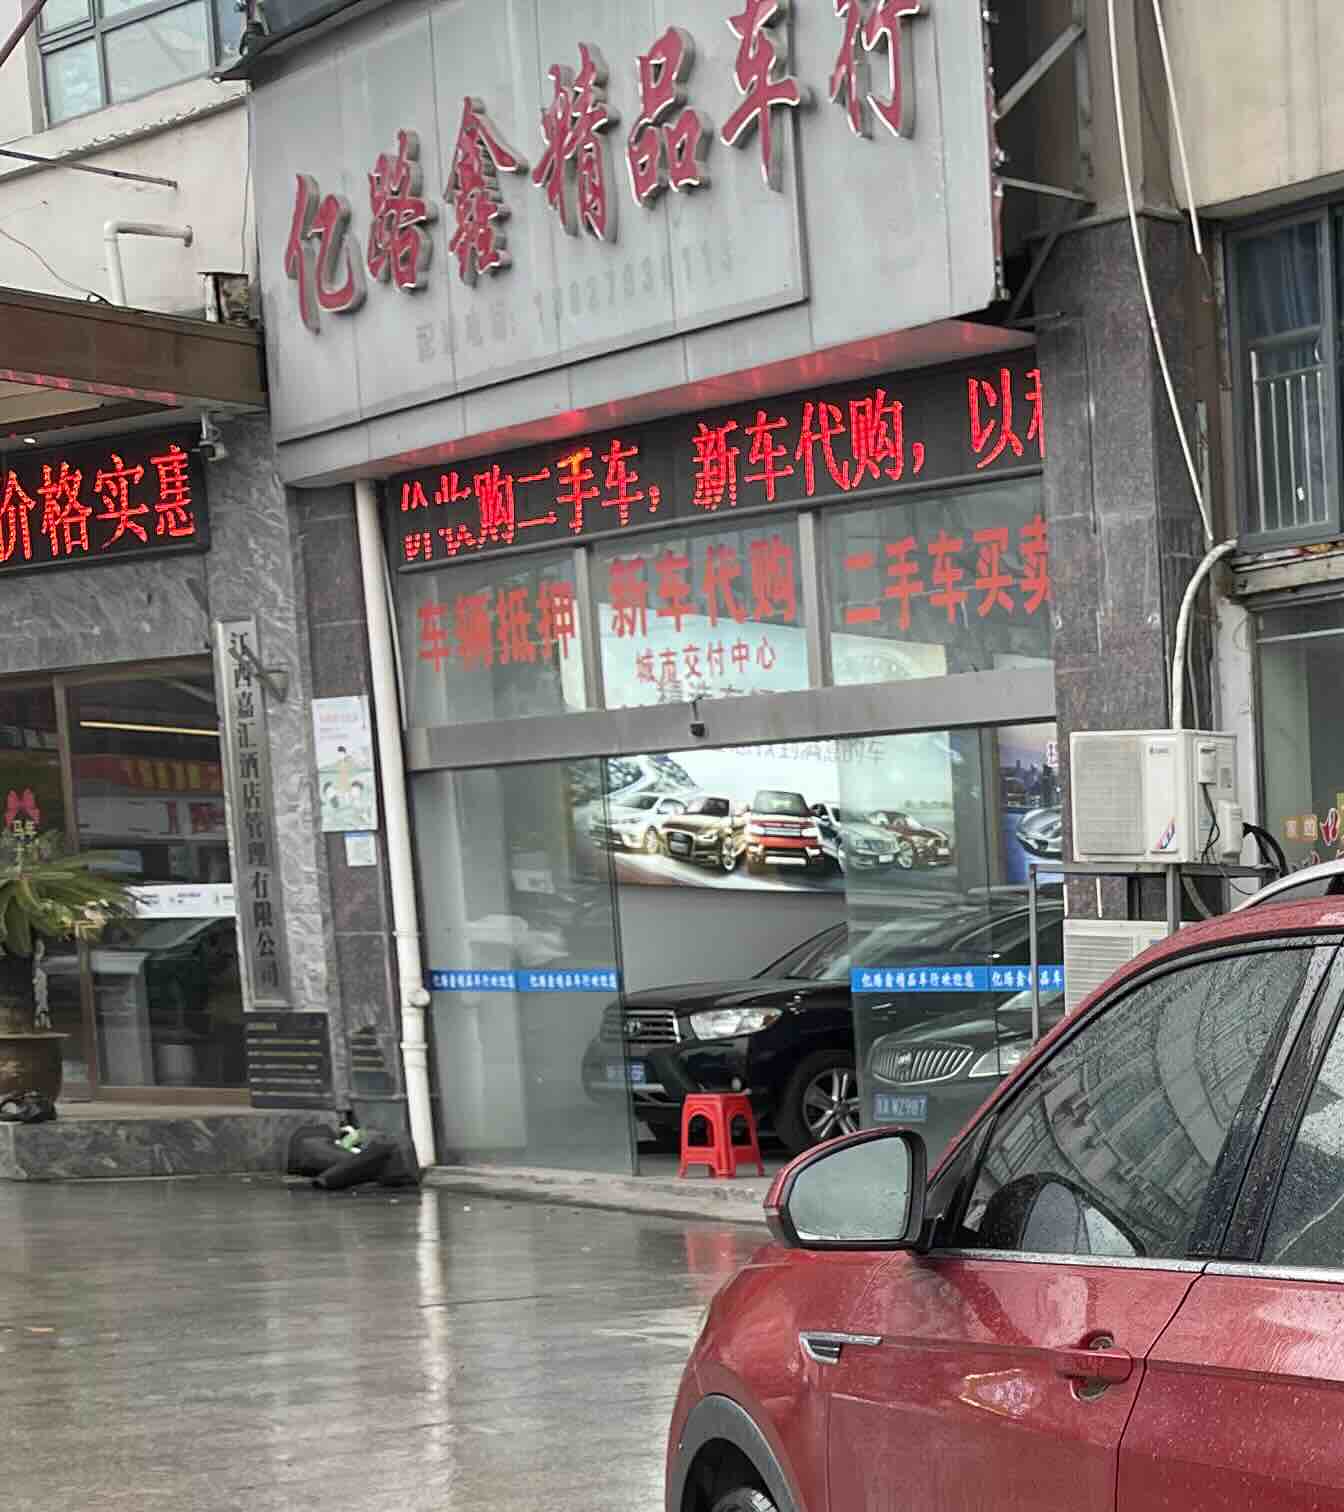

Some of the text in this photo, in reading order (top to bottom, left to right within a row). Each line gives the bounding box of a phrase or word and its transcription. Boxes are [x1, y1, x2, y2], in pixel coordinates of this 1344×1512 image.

[0, 444, 194, 561] 价格实惠
[609, 535, 796, 640] 新车代购
[845, 513, 1049, 631] 二手车买卖
[417, 581, 576, 672] 车辆抵押
[636, 636, 776, 684] 城市交付中心
